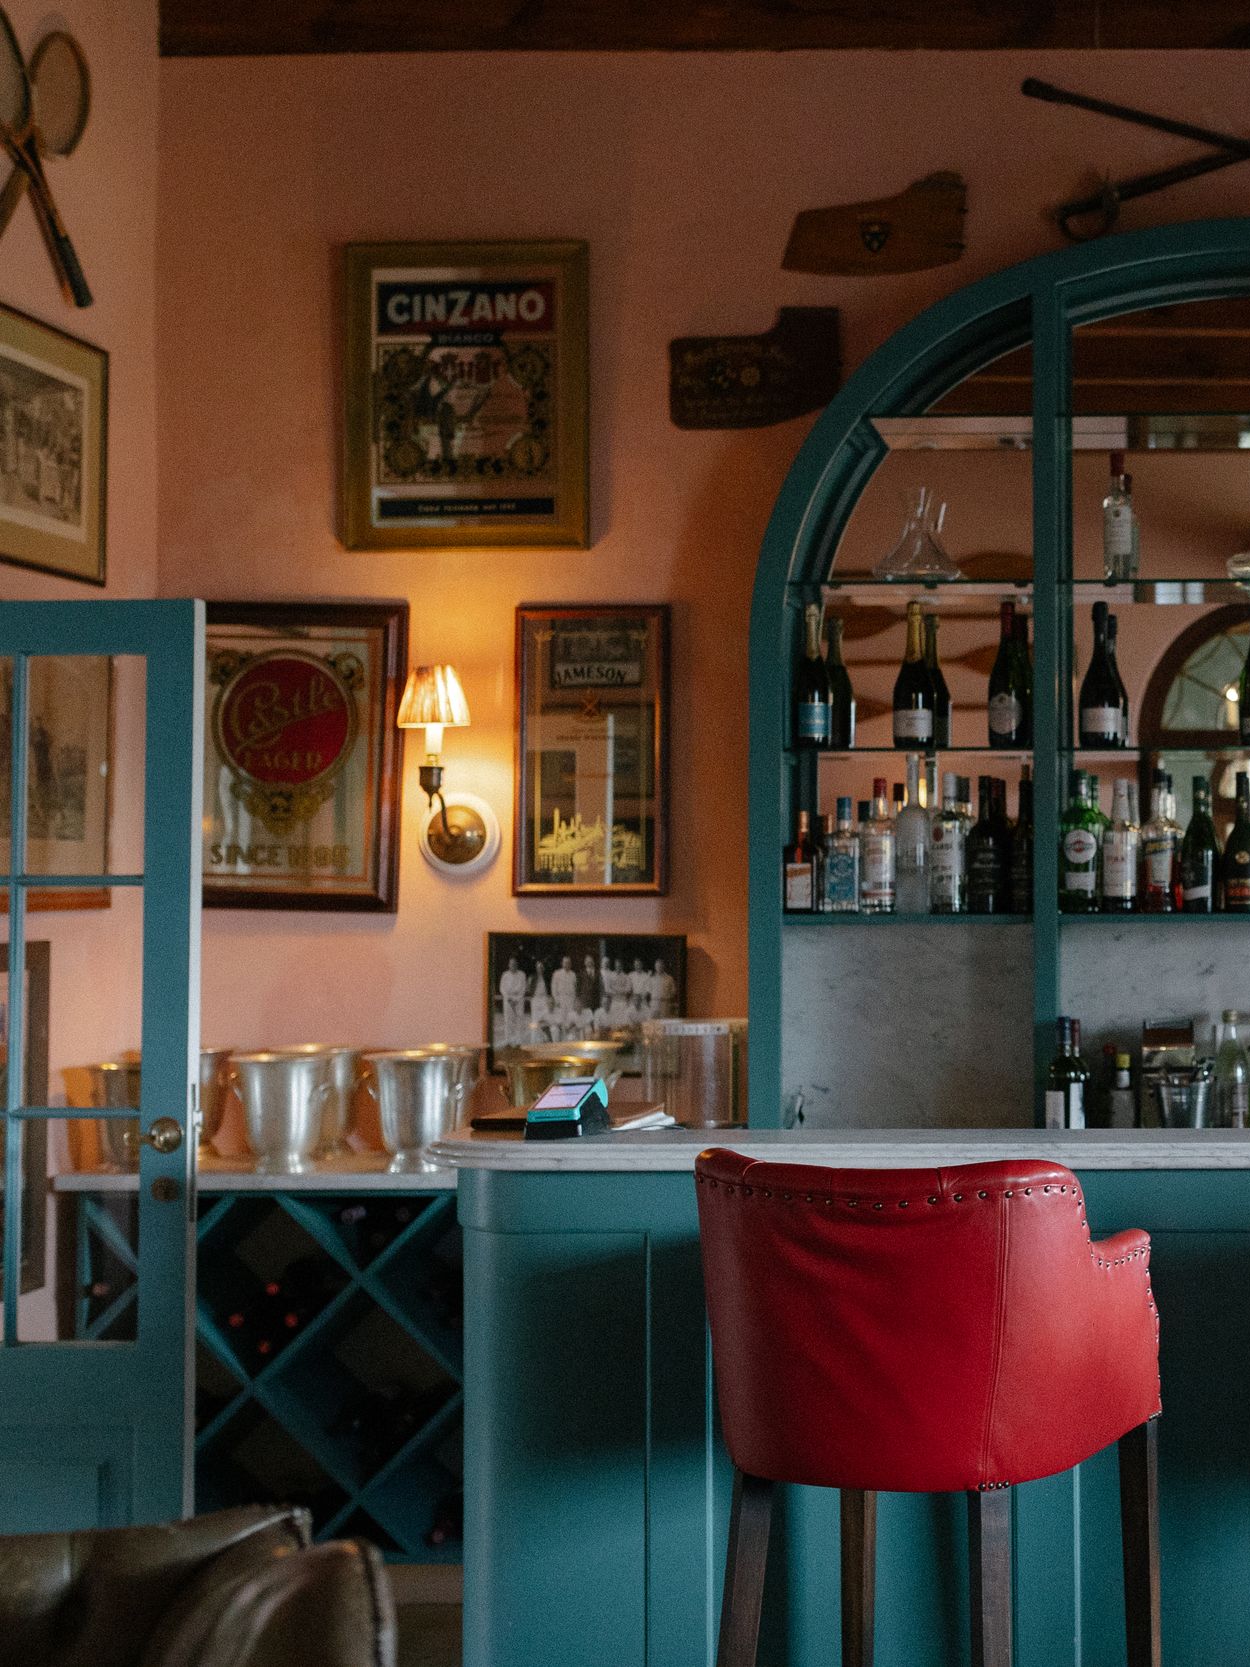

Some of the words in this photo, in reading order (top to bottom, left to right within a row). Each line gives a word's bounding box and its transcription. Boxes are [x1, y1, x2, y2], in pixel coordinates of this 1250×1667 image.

[386, 290, 546, 326] CINZANO
[555, 665, 626, 686] JAMESON
[210, 844, 281, 867] SINCE
